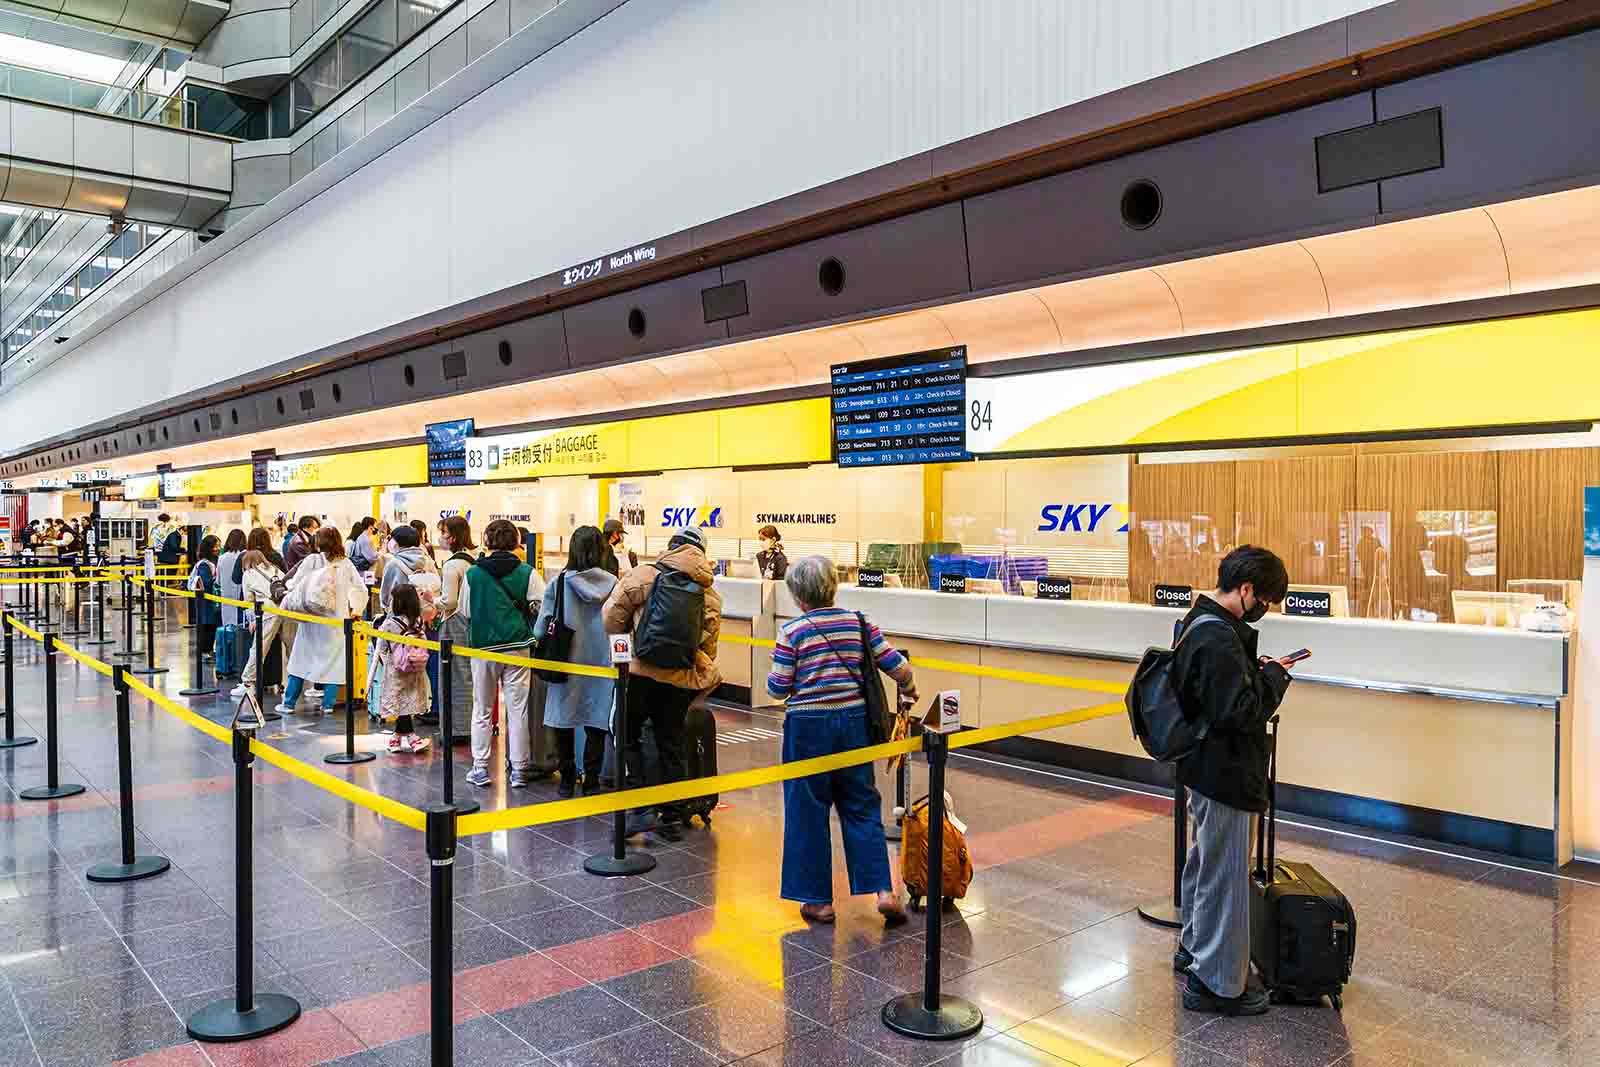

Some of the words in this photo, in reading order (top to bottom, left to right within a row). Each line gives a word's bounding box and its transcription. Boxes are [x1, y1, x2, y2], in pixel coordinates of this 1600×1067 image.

[610, 252, 633, 269] North
[633, 247, 656, 261] Wing
[563, 258, 602, 285] 北ウイング
[833, 387, 847, 395] 11:00
[890, 380, 897, 388] 21
[944, 372, 960, 381] Closed
[834, 401, 848, 409] 11:05
[892, 409, 900, 417] 22
[971, 399, 993, 432] 84
[879, 425, 889, 433] 011
[555, 434, 598, 453] BAGGAGE
[468, 449, 483, 468] 83
[502, 443, 553, 466] 手荷物受付
[75, 473, 87, 481] 18
[95, 470, 108, 479] 19
[269, 469, 280, 483] 82
[661, 507, 697, 527] SKY
[756, 513, 796, 524] SKYMARK
[796, 513, 837, 524] AIRLINES
[1038, 504, 1113, 532] SKY
[859, 573, 883, 583] Closed
[941, 577, 965, 588] Closed
[1038, 583, 1071, 593] Closed
[1156, 589, 1191, 601] Closed
[1286, 596, 1329, 609] Closed
